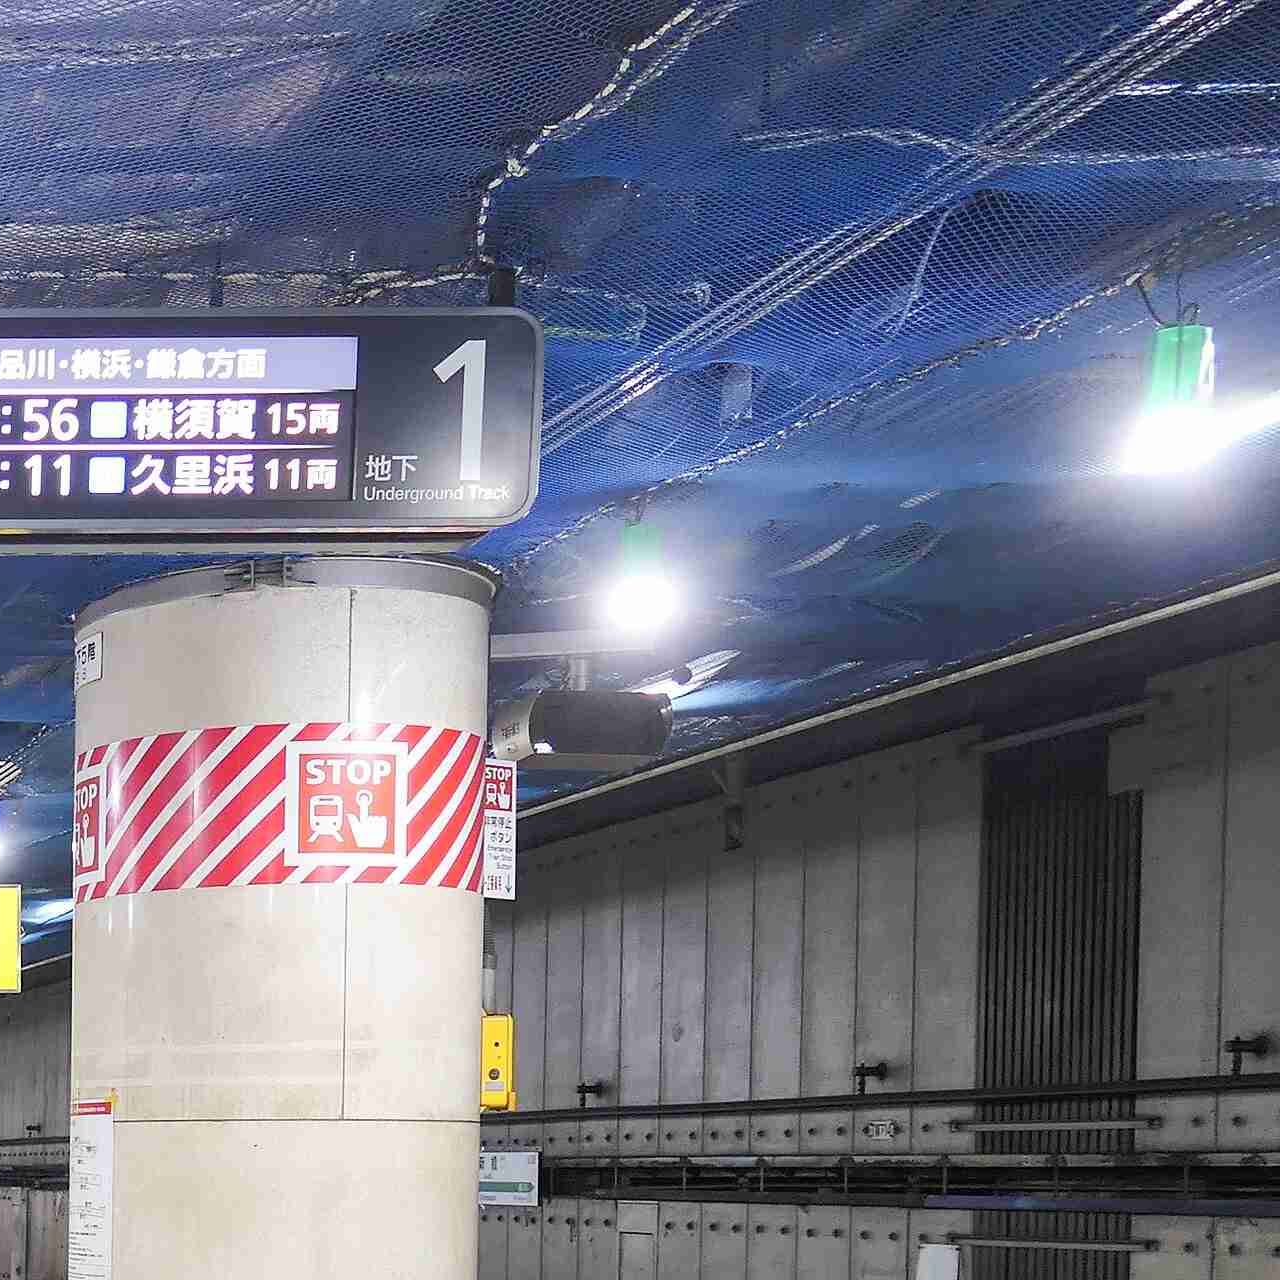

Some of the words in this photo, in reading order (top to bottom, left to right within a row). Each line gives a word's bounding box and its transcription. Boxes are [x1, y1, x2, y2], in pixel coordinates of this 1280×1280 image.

[132, 399, 257, 440] 横須賀
[266, 402, 340, 434] 15両
[433, 340, 486, 481] 1
[131, 454, 254, 496] 久里浜
[265, 458, 337, 490] 11両
[365, 455, 417, 482] 地下
[364, 486, 463, 503] Underground
[467, 484, 510, 501] Track
[305, 758, 391, 786] STOP
[485, 767, 512, 781] STOP
[76, 783, 97, 812] TOP
